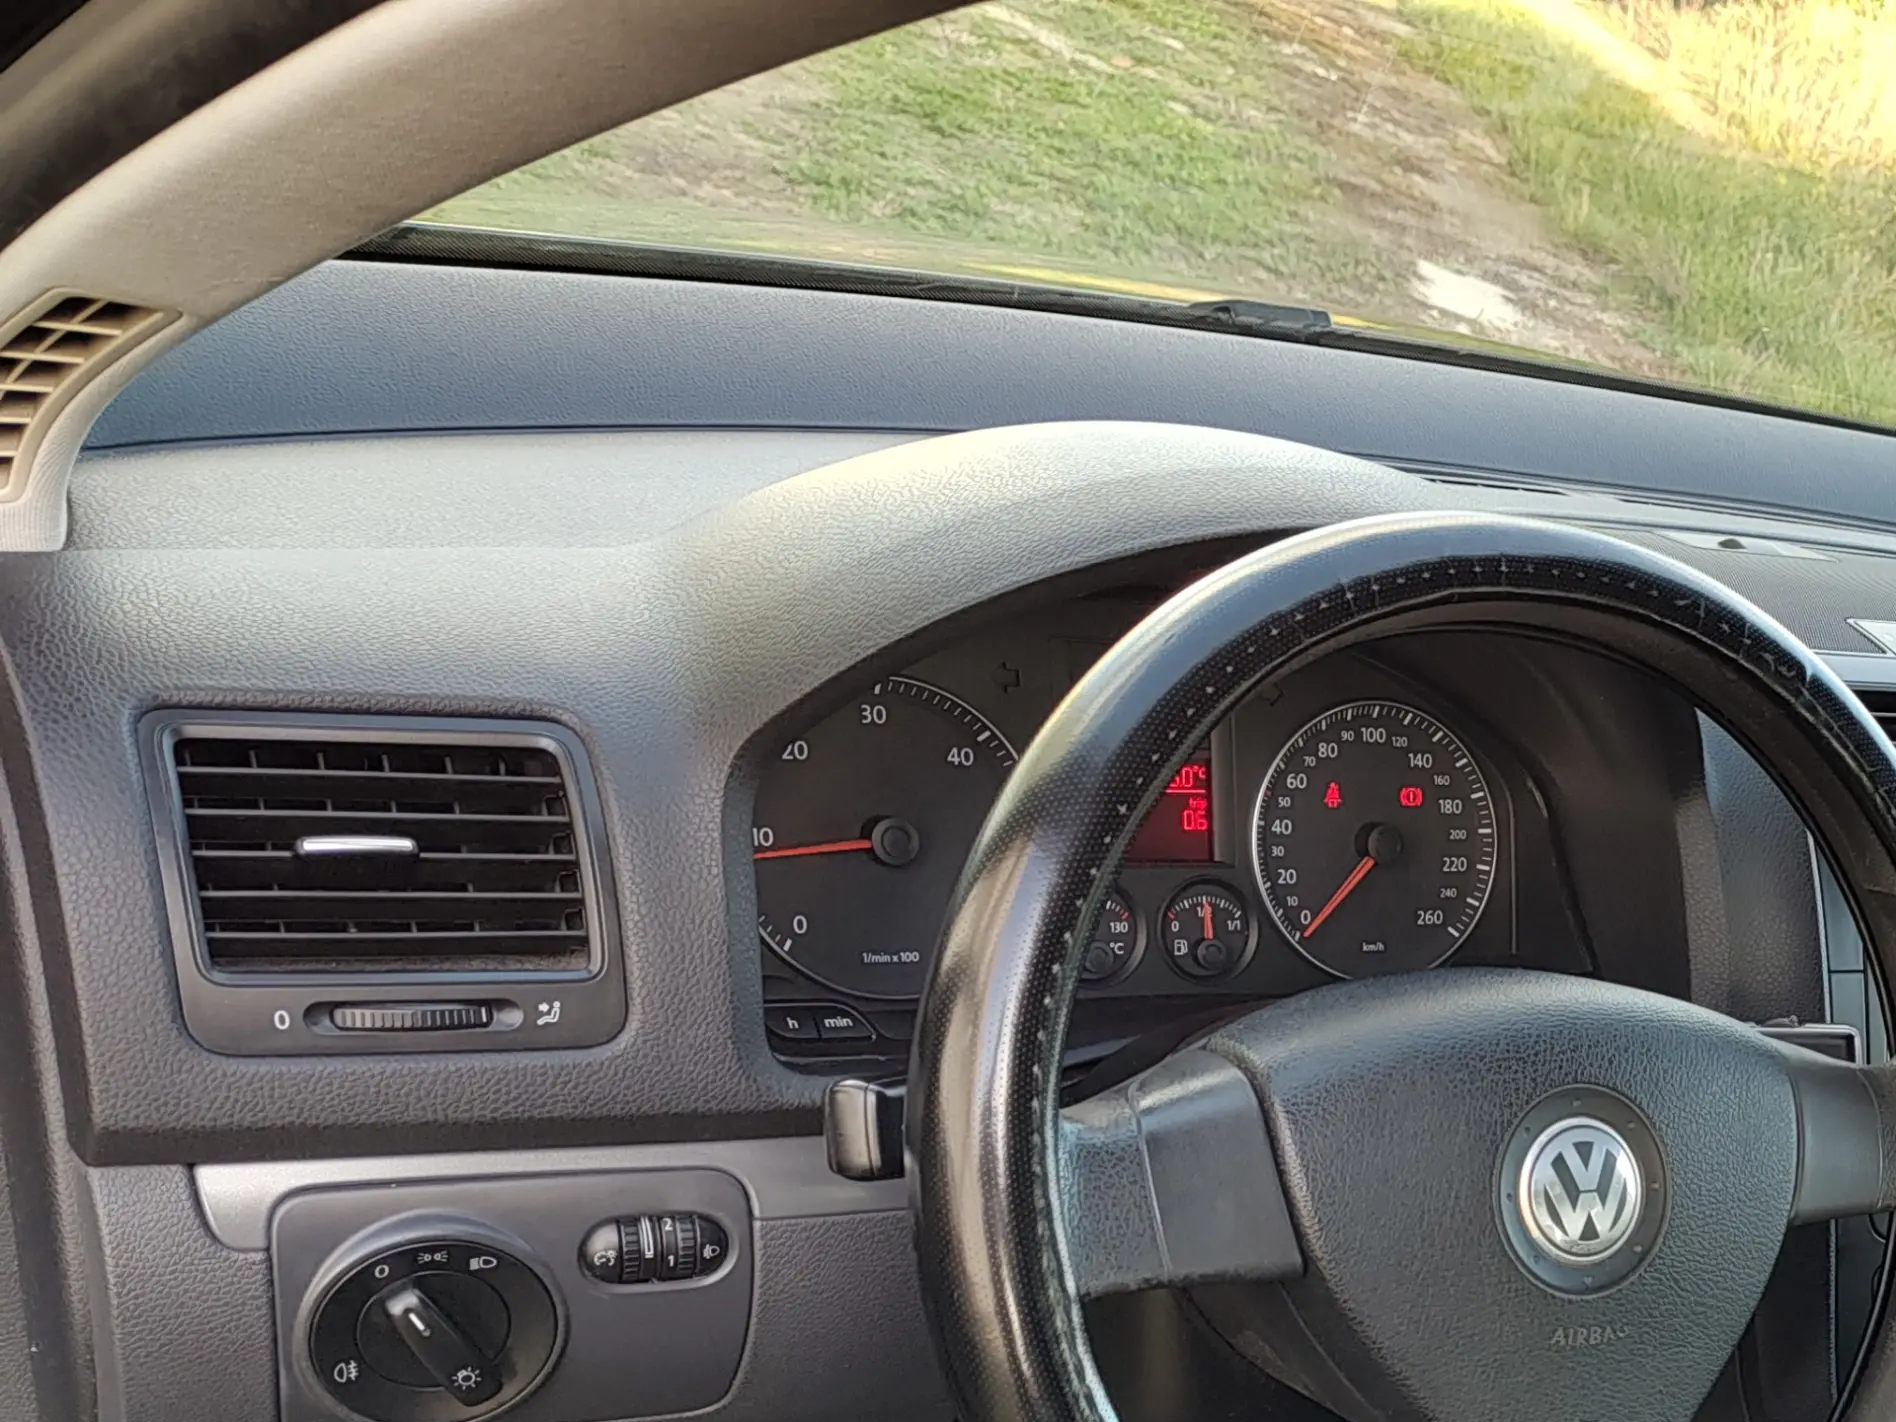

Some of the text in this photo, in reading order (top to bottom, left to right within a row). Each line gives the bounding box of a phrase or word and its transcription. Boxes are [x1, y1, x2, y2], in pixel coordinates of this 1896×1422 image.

[860, 705, 887, 724] 30
[1341, 730, 1354, 741] 90
[1360, 727, 1386, 743] 100
[1392, 736, 1408, 747] 120
[782, 741, 808, 760] 20
[947, 747, 974, 766] 40
[1318, 743, 1338, 758] 80
[1303, 756, 1316, 767] 70
[1408, 753, 1432, 769] 140
[1286, 773, 1307, 789] 60
[1433, 775, 1450, 786] 160
[1278, 797, 1291, 808] 50
[1439, 799, 1462, 814] 180
[1271, 819, 1292, 835] 40
[752, 827, 774, 847] 10
[1449, 829, 1467, 840] 200
[1271, 846, 1284, 857] 30
[1442, 857, 1467, 872] 220
[1277, 869, 1296, 884] 20
[1440, 888, 1457, 899] 240
[1287, 896, 1298, 907] 10
[793, 915, 807, 934] 0
[1300, 910, 1311, 925] 0
[1417, 910, 1443, 925] 260
[1110, 921, 1128, 933] 130
[1171, 921, 1180, 932] 0
[1362, 942, 1385, 952] km/h
[274, 1009, 291, 1030] 0
[787, 1017, 799, 1029] h
[824, 1015, 854, 1028] min
[662, 1218, 674, 1231] 2
[667, 1255, 675, 1267] 1
